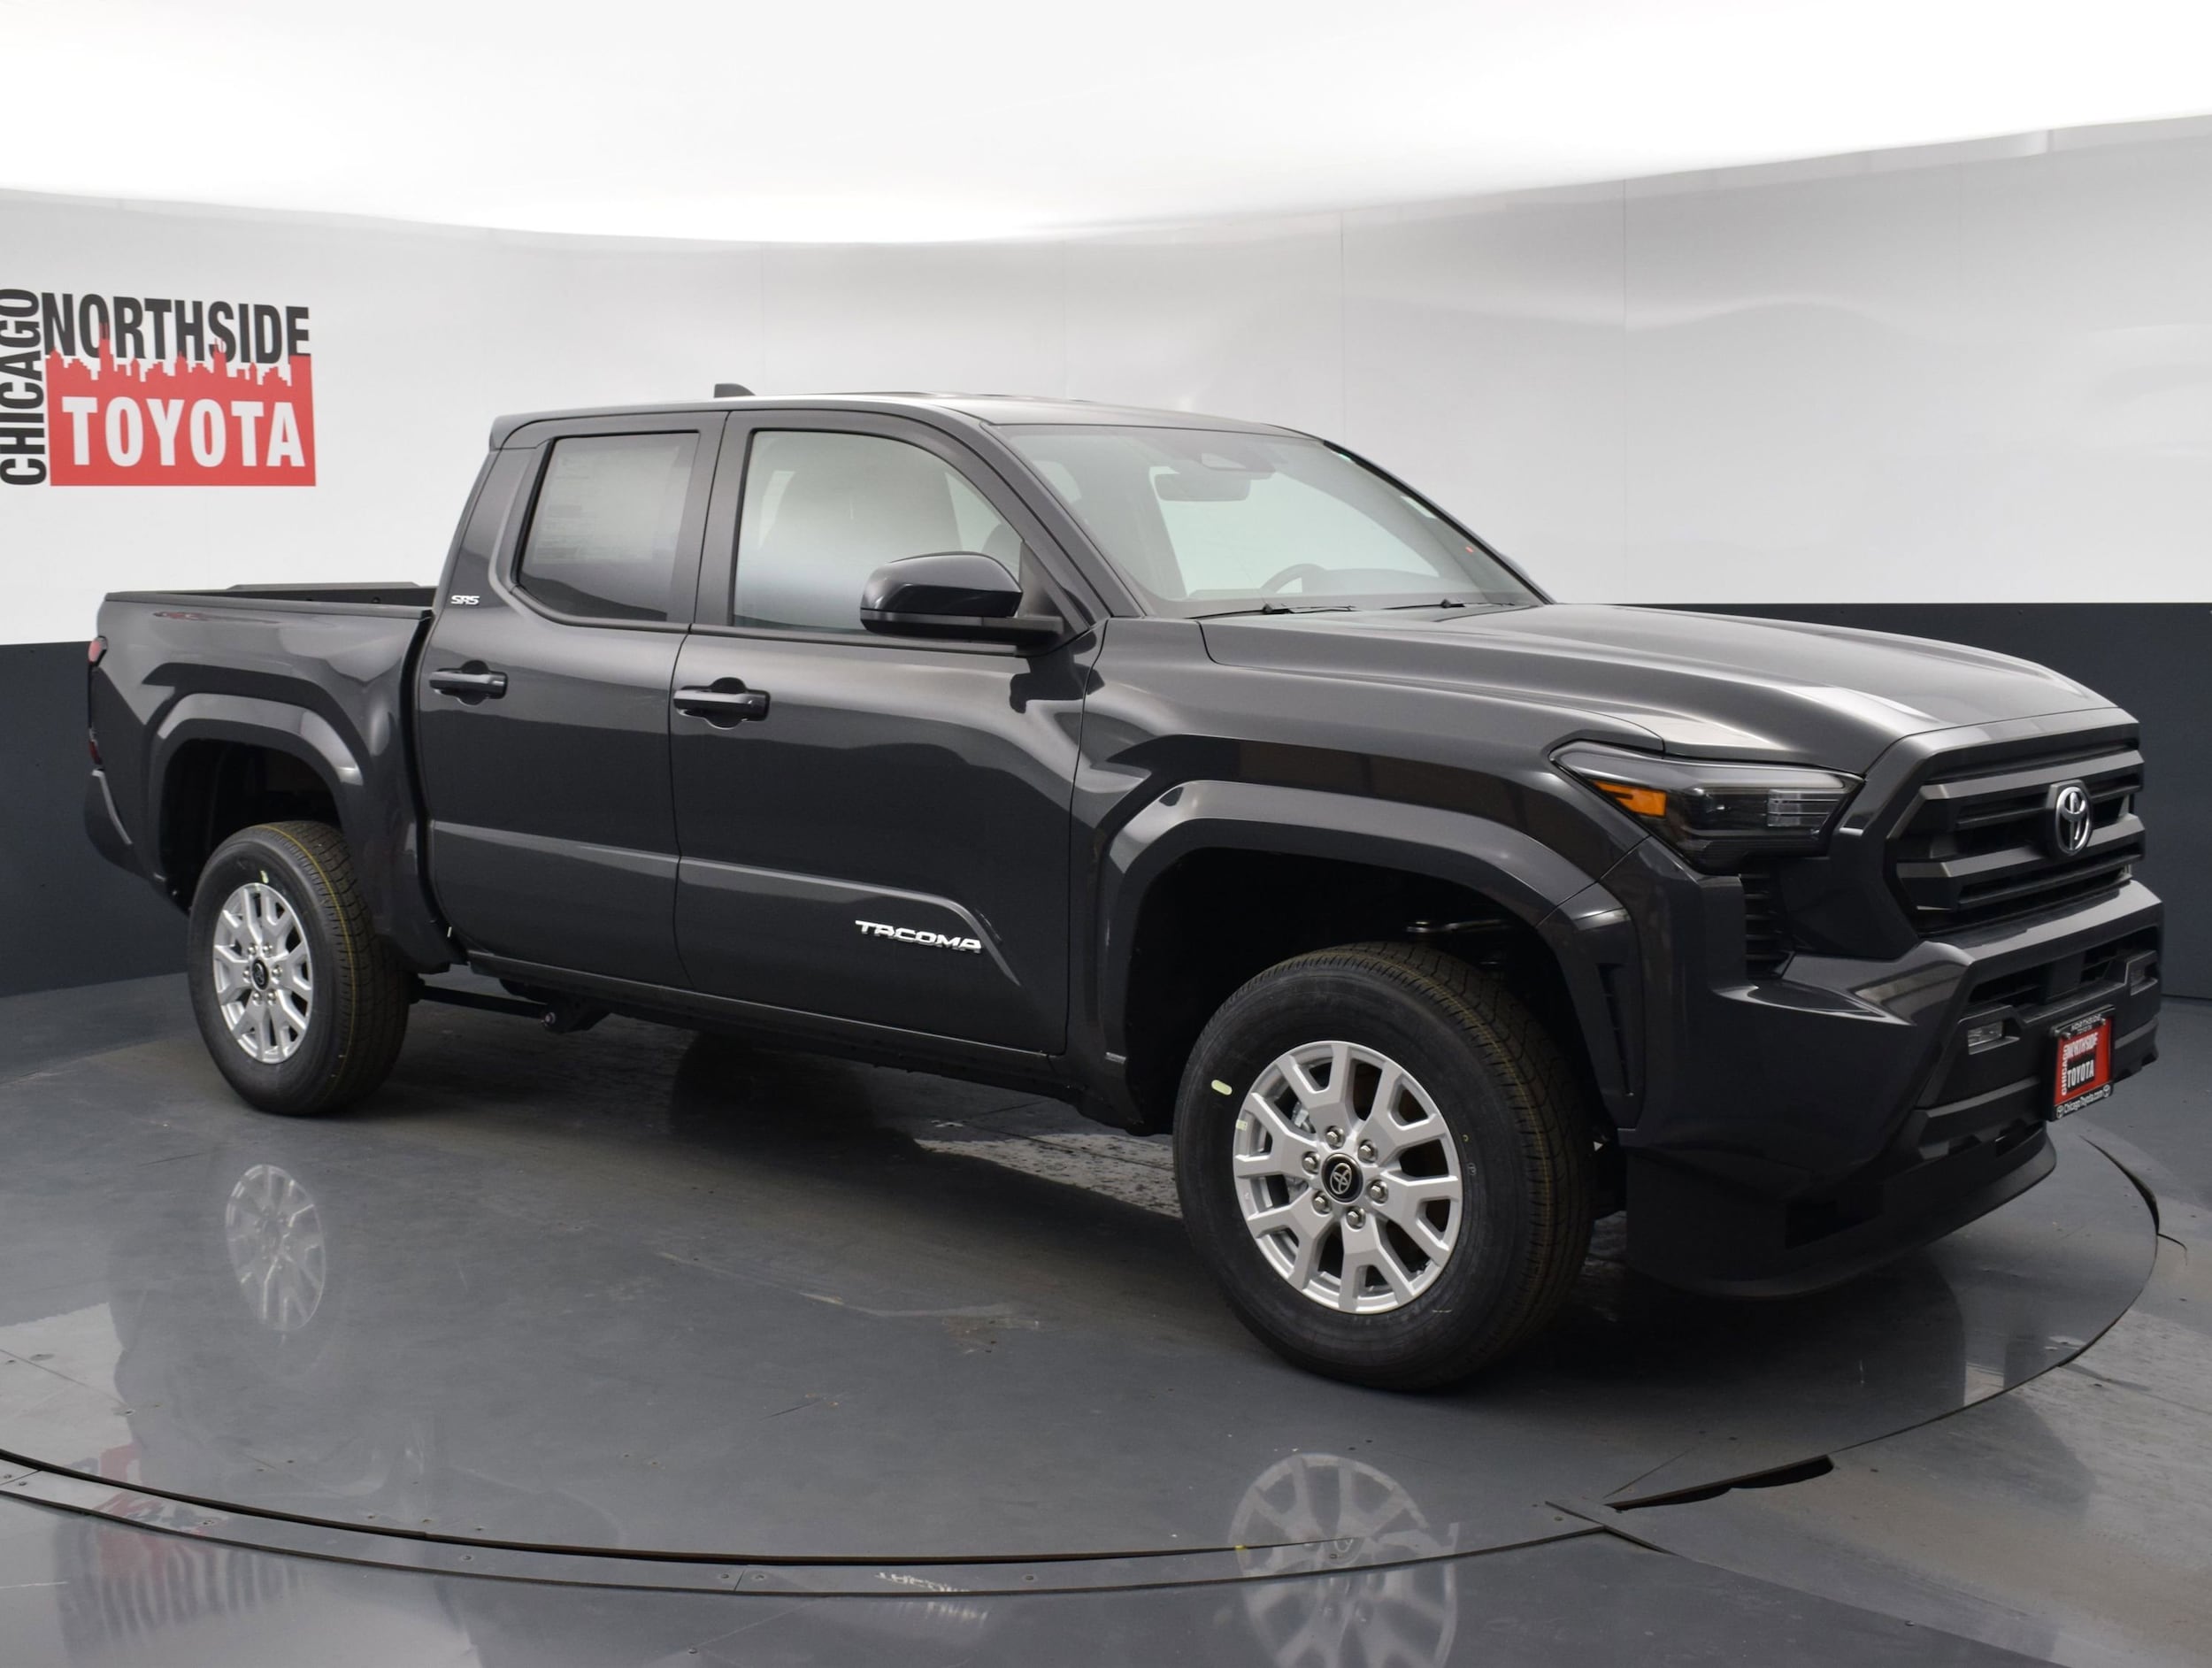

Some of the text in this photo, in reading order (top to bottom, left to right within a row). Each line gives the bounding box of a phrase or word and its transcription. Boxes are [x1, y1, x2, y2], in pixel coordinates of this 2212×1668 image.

[42, 292, 311, 365] NORTHSIDE
[0, 288, 47, 485] CHICAGO
[62, 396, 305, 467] TOYOTA
[451, 595, 480, 605] SR5
[855, 920, 981, 953] TACOMA
[2067, 1059, 2094, 1088] TOYOTA
